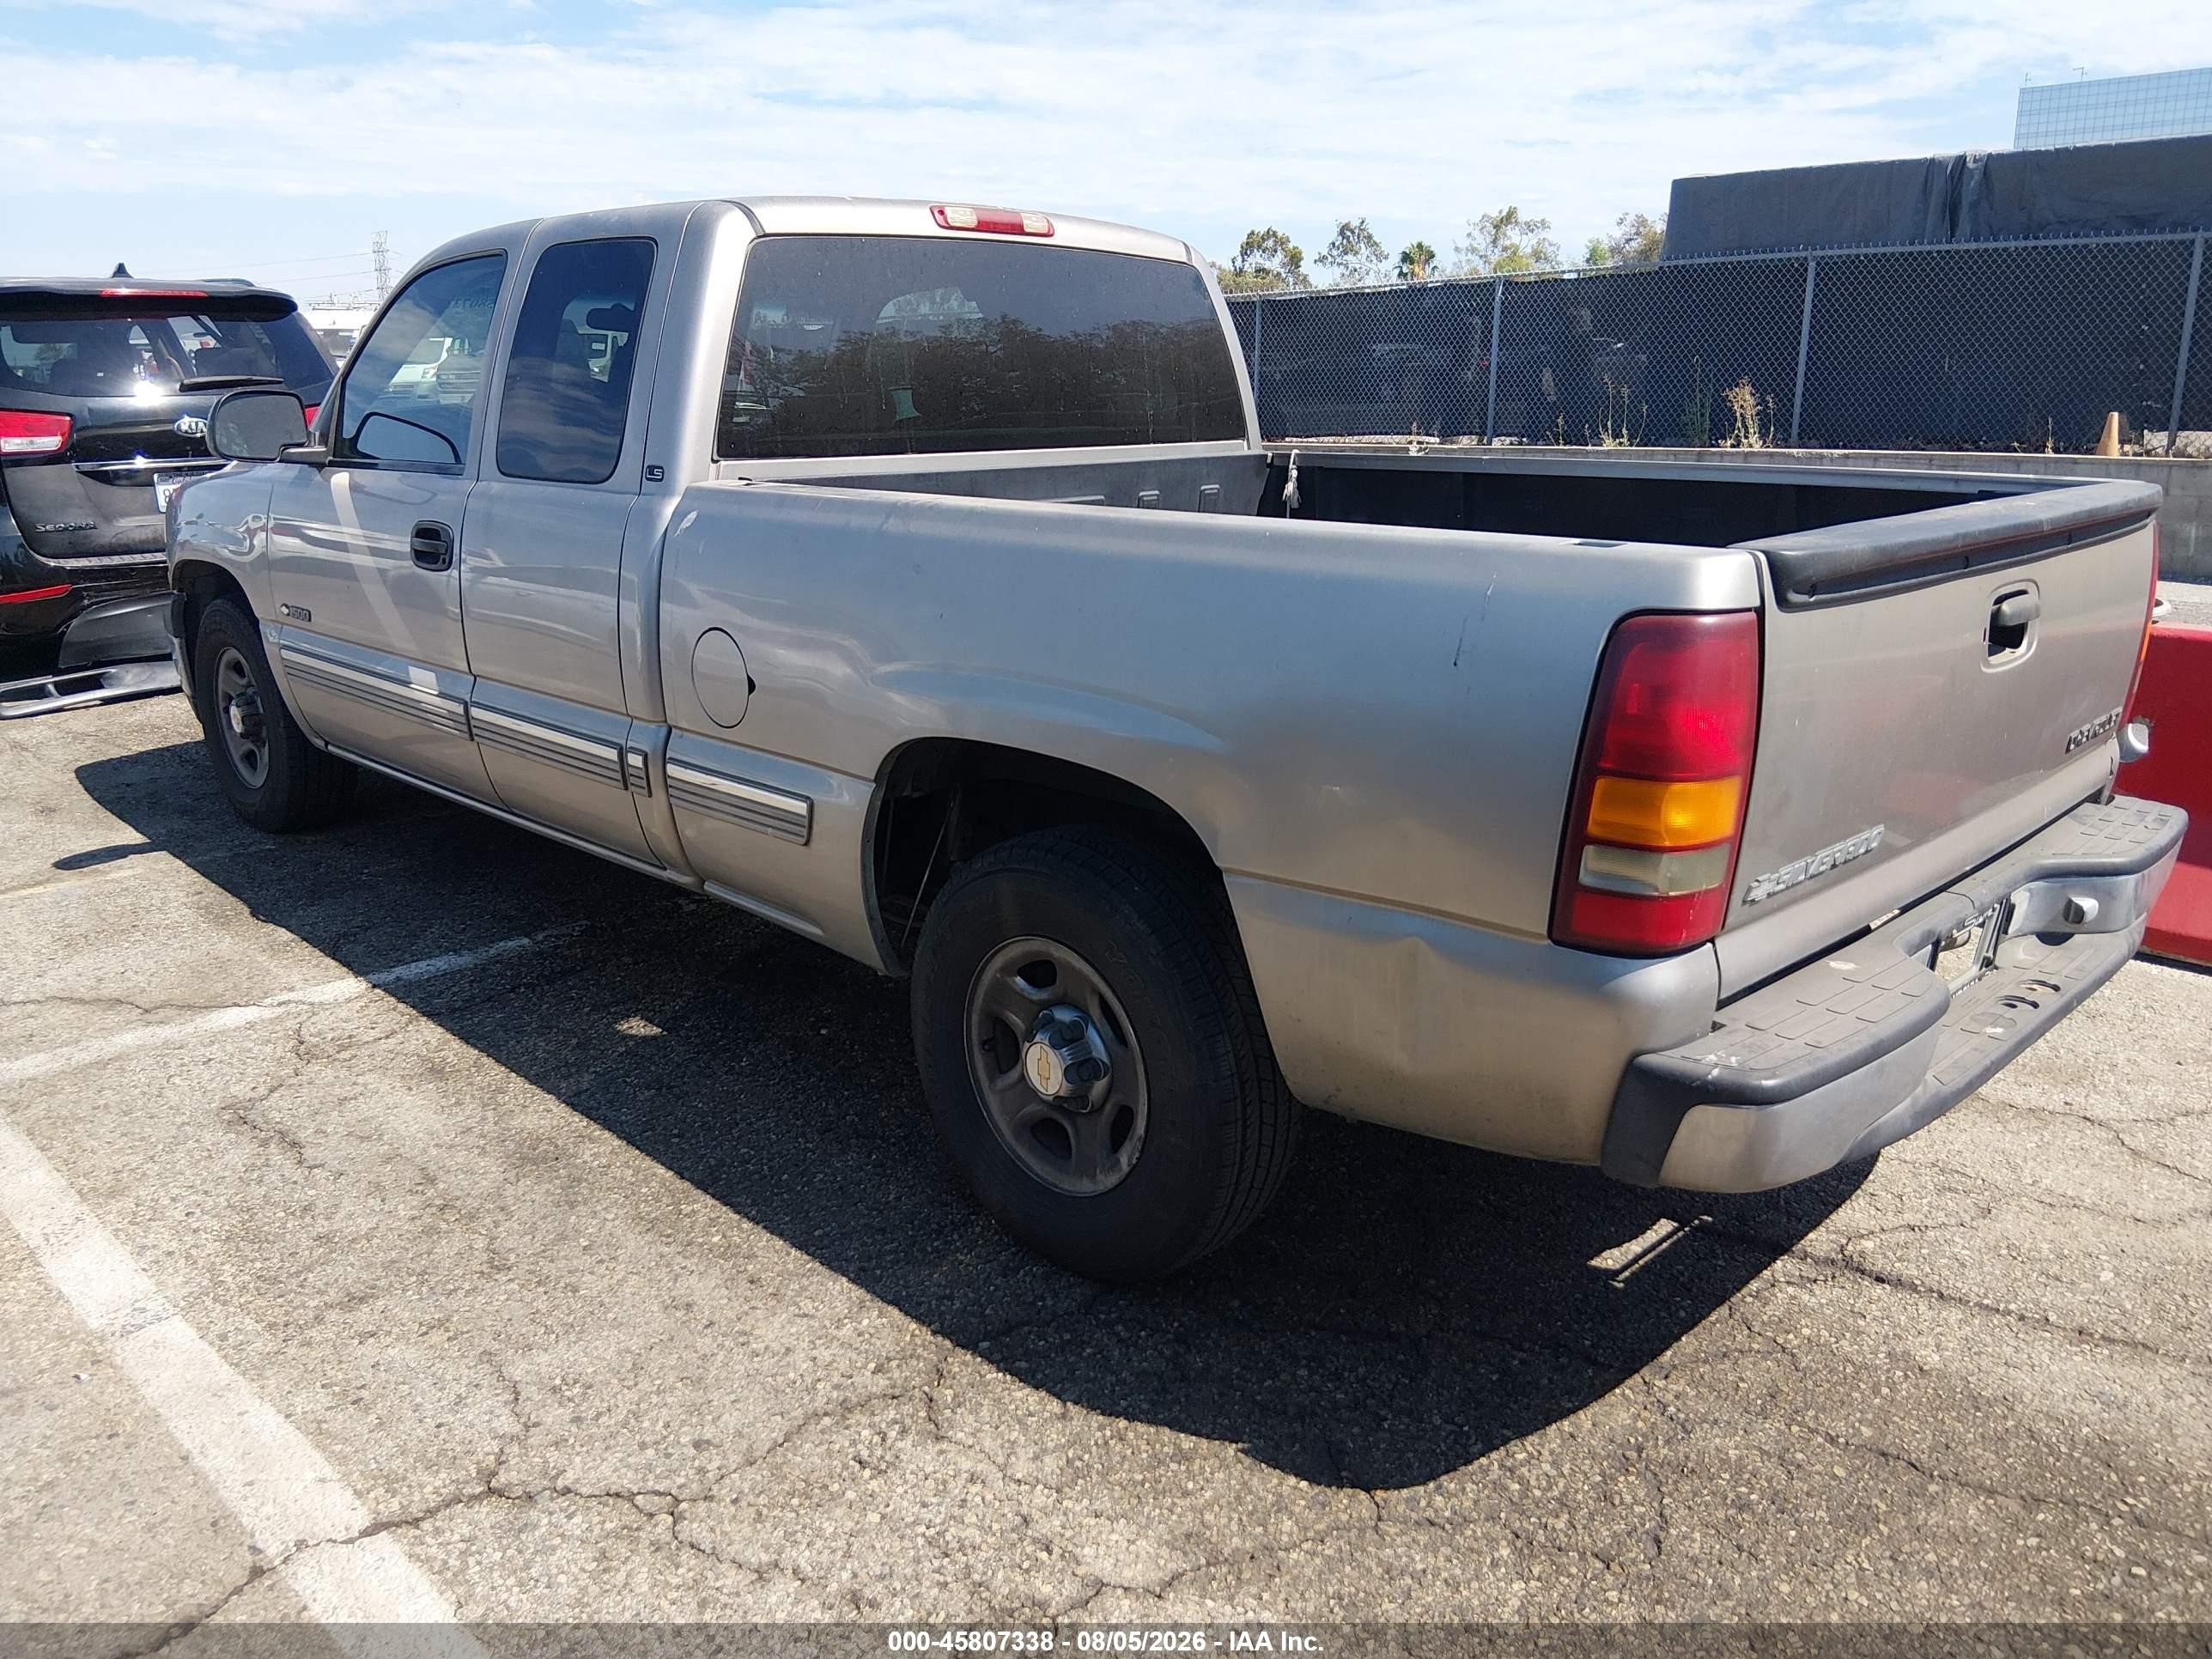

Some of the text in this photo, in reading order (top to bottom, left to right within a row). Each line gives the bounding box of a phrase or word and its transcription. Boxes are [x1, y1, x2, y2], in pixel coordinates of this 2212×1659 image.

[179, 421, 207, 434] KIA
[646, 468, 664, 480] LS
[35, 521, 98, 532] SEDONA
[289, 606, 311, 622] 1500
